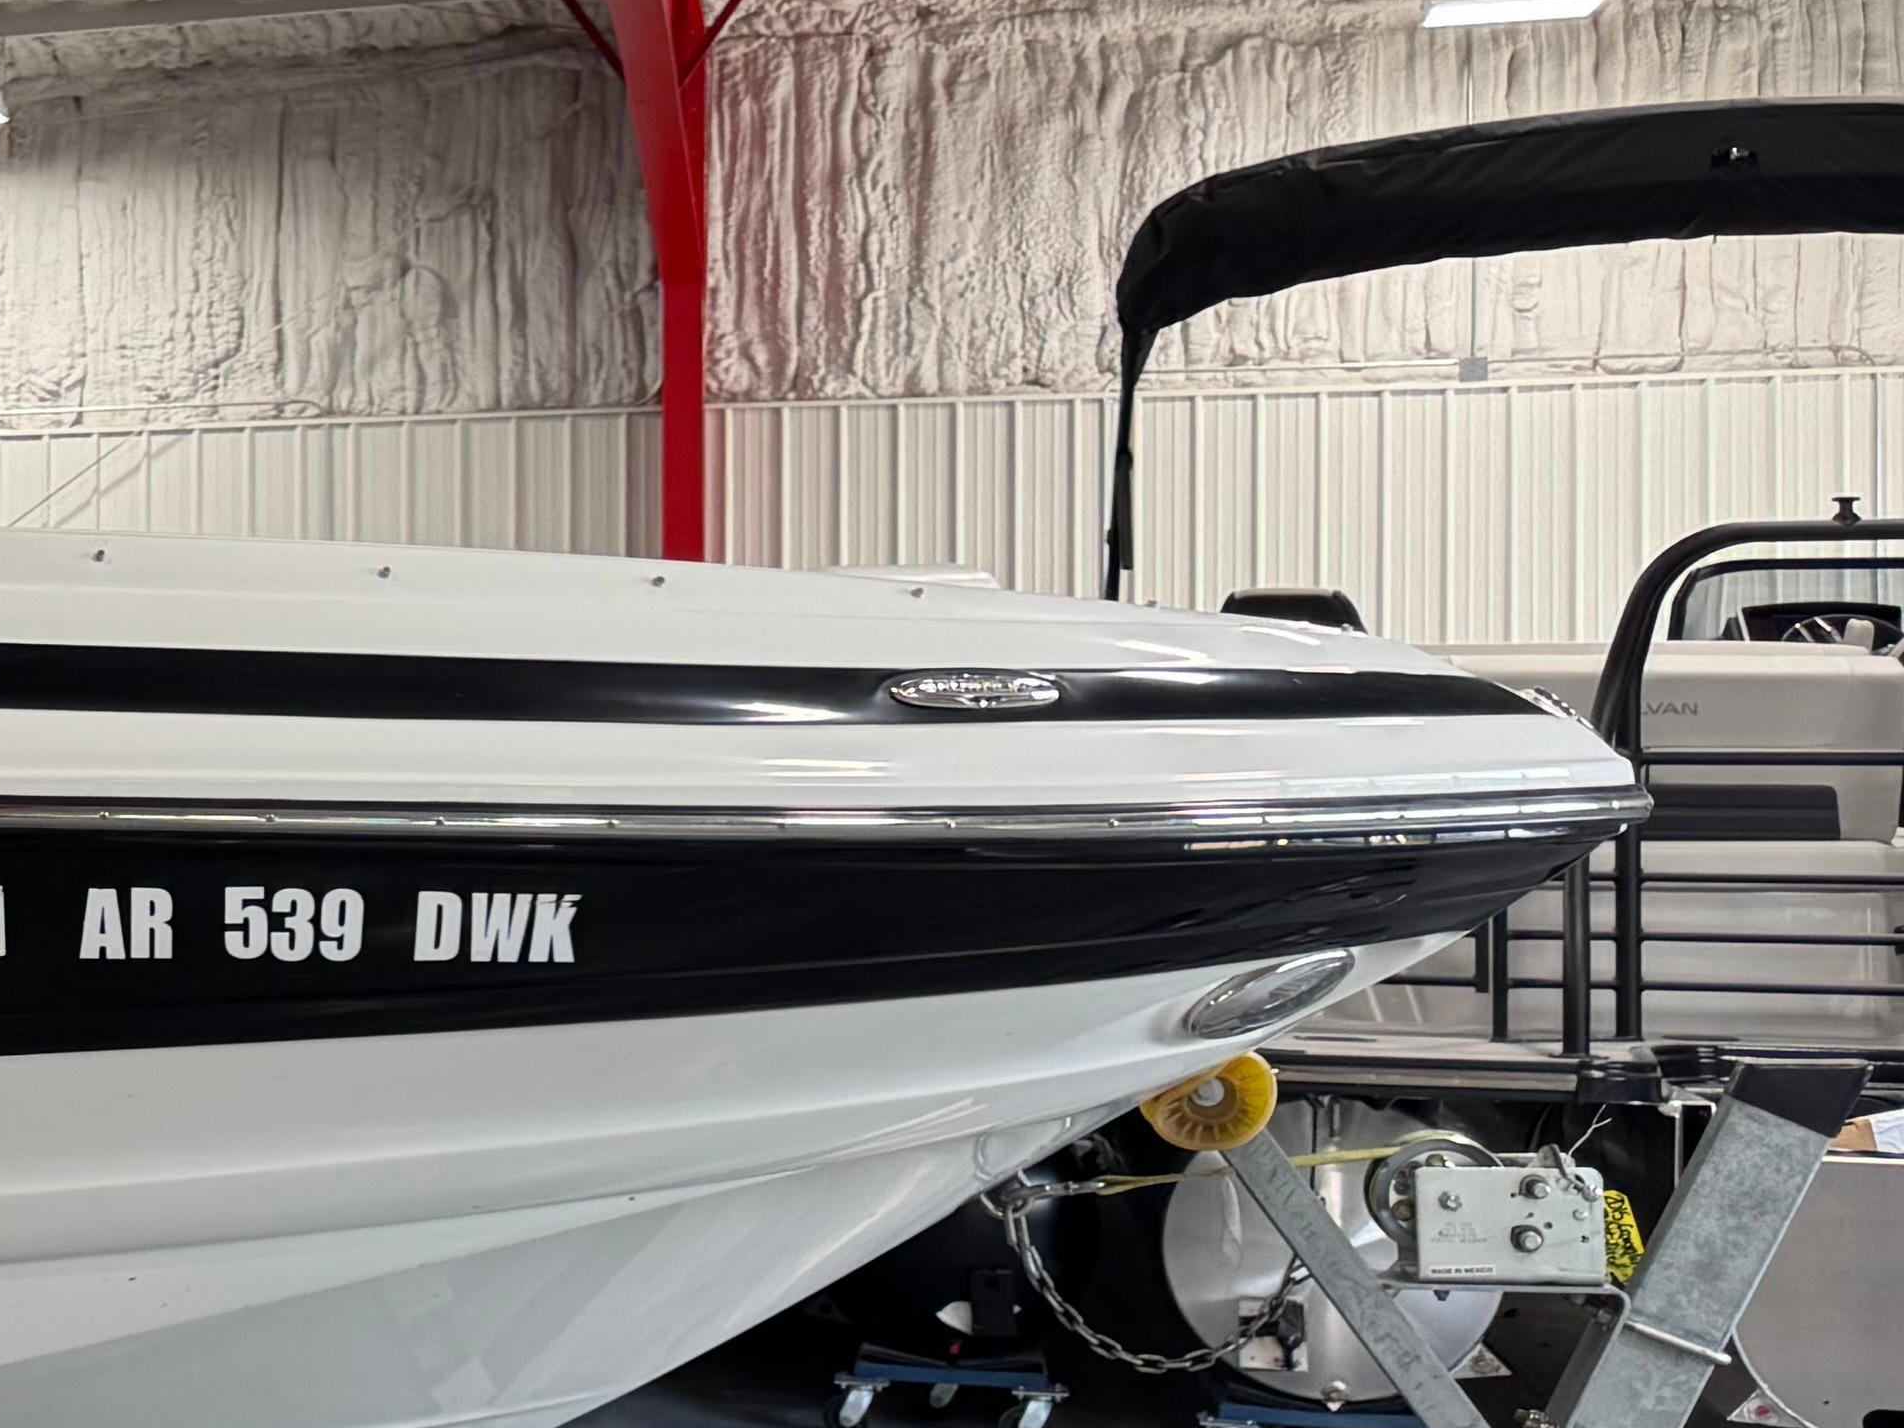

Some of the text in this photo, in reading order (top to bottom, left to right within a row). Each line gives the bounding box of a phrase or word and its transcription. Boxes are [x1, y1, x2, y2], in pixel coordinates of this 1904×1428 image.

[1641, 702, 1698, 716] VAN
[79, 886, 583, 963] AR 539 DWK
